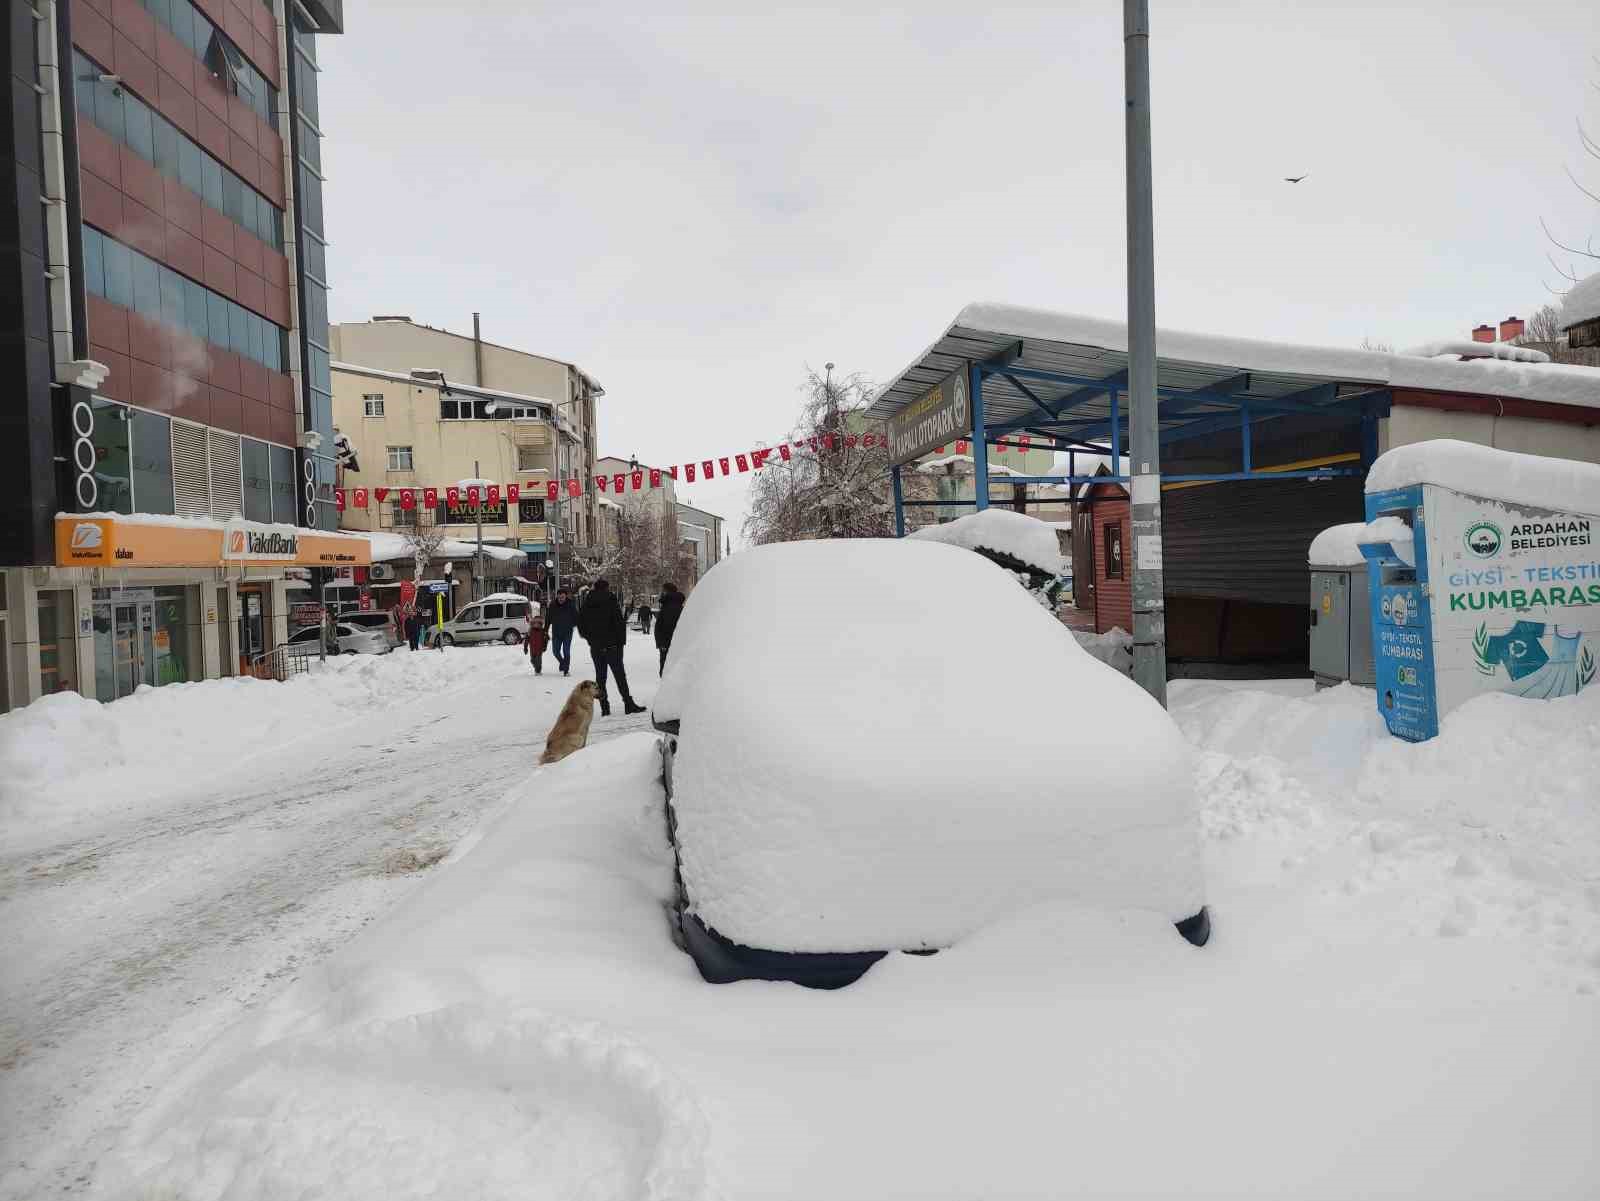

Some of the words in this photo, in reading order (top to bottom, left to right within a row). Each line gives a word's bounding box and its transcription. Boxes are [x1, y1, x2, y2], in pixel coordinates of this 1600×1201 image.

[919, 406, 955, 446] OTOPARK
[450, 501, 505, 514] AVUKAT
[1510, 521, 1590, 536] ARDAHAN
[248, 530, 298, 554] VakıfBank
[1511, 533, 1591, 550] BELEDİYESİ
[1449, 567, 1503, 587] GİYSİ
[1524, 560, 1600, 582] TEKSTİ
